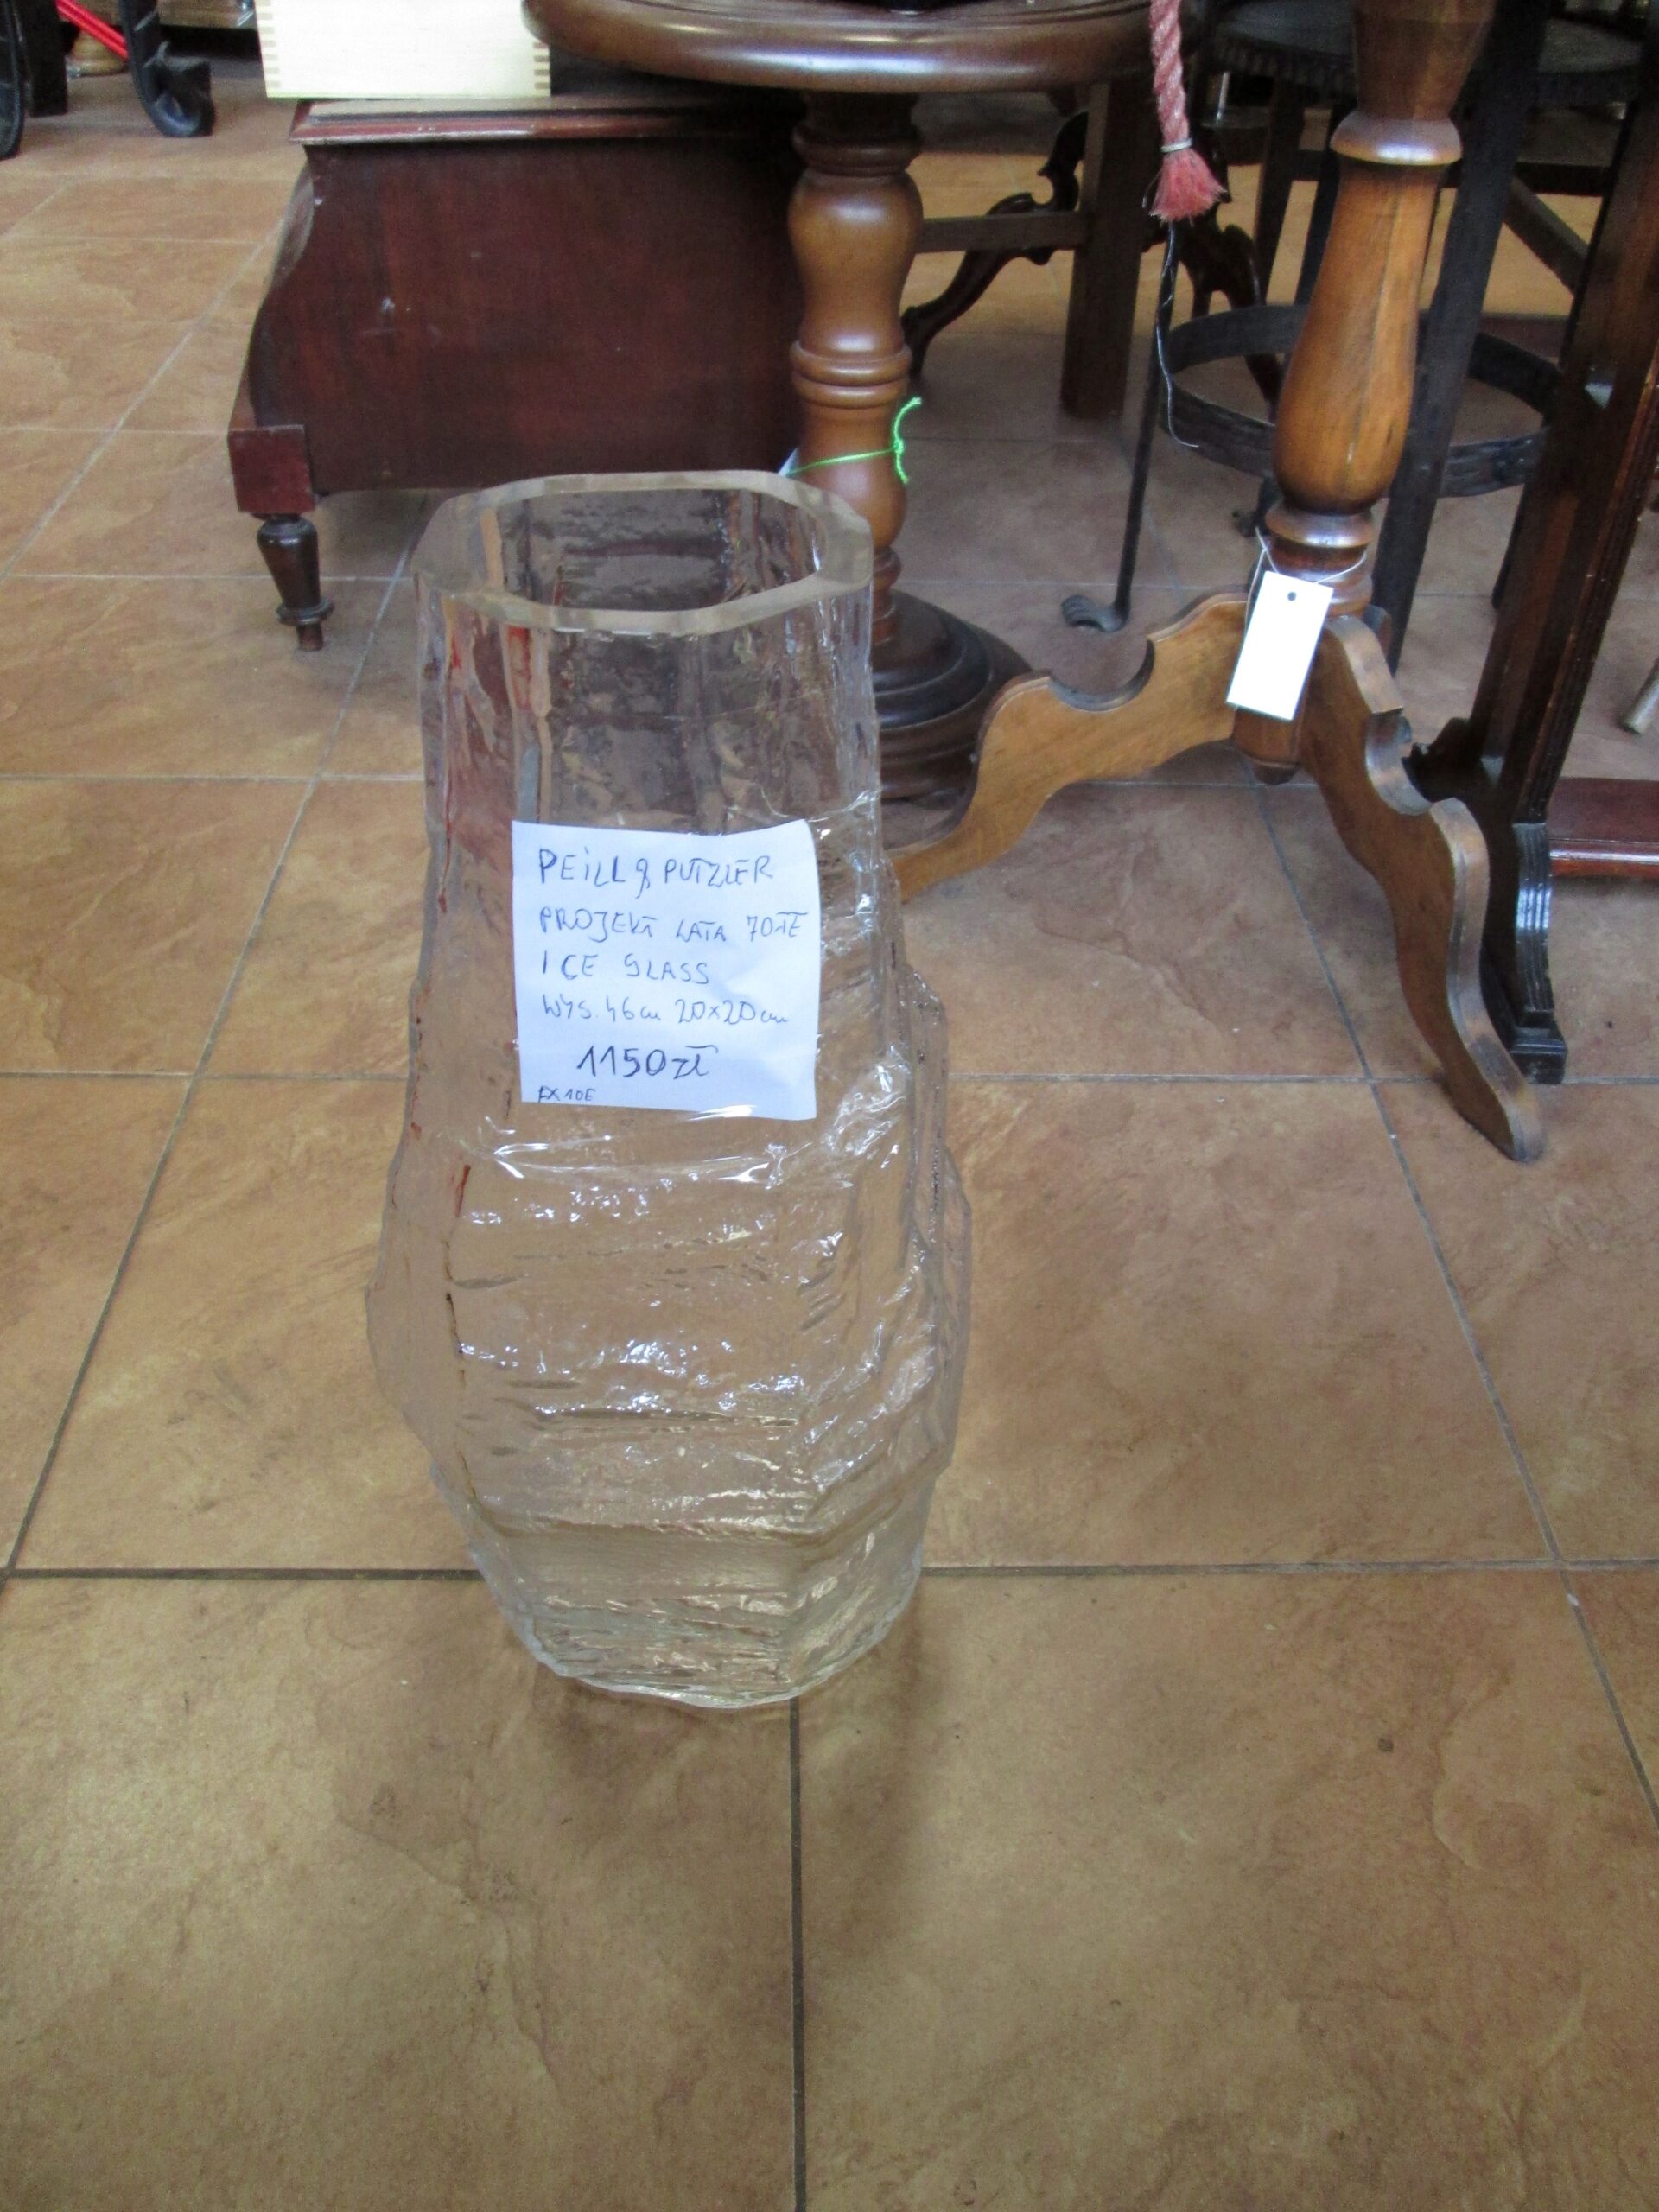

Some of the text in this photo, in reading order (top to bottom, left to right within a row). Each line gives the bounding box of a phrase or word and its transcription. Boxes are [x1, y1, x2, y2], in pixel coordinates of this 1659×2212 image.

[664, 855, 773, 887] PUTZLER
[539, 906, 658, 943] PROJEKT
[676, 919, 726, 942] LATA
[542, 950, 709, 985] ICE GLASS
